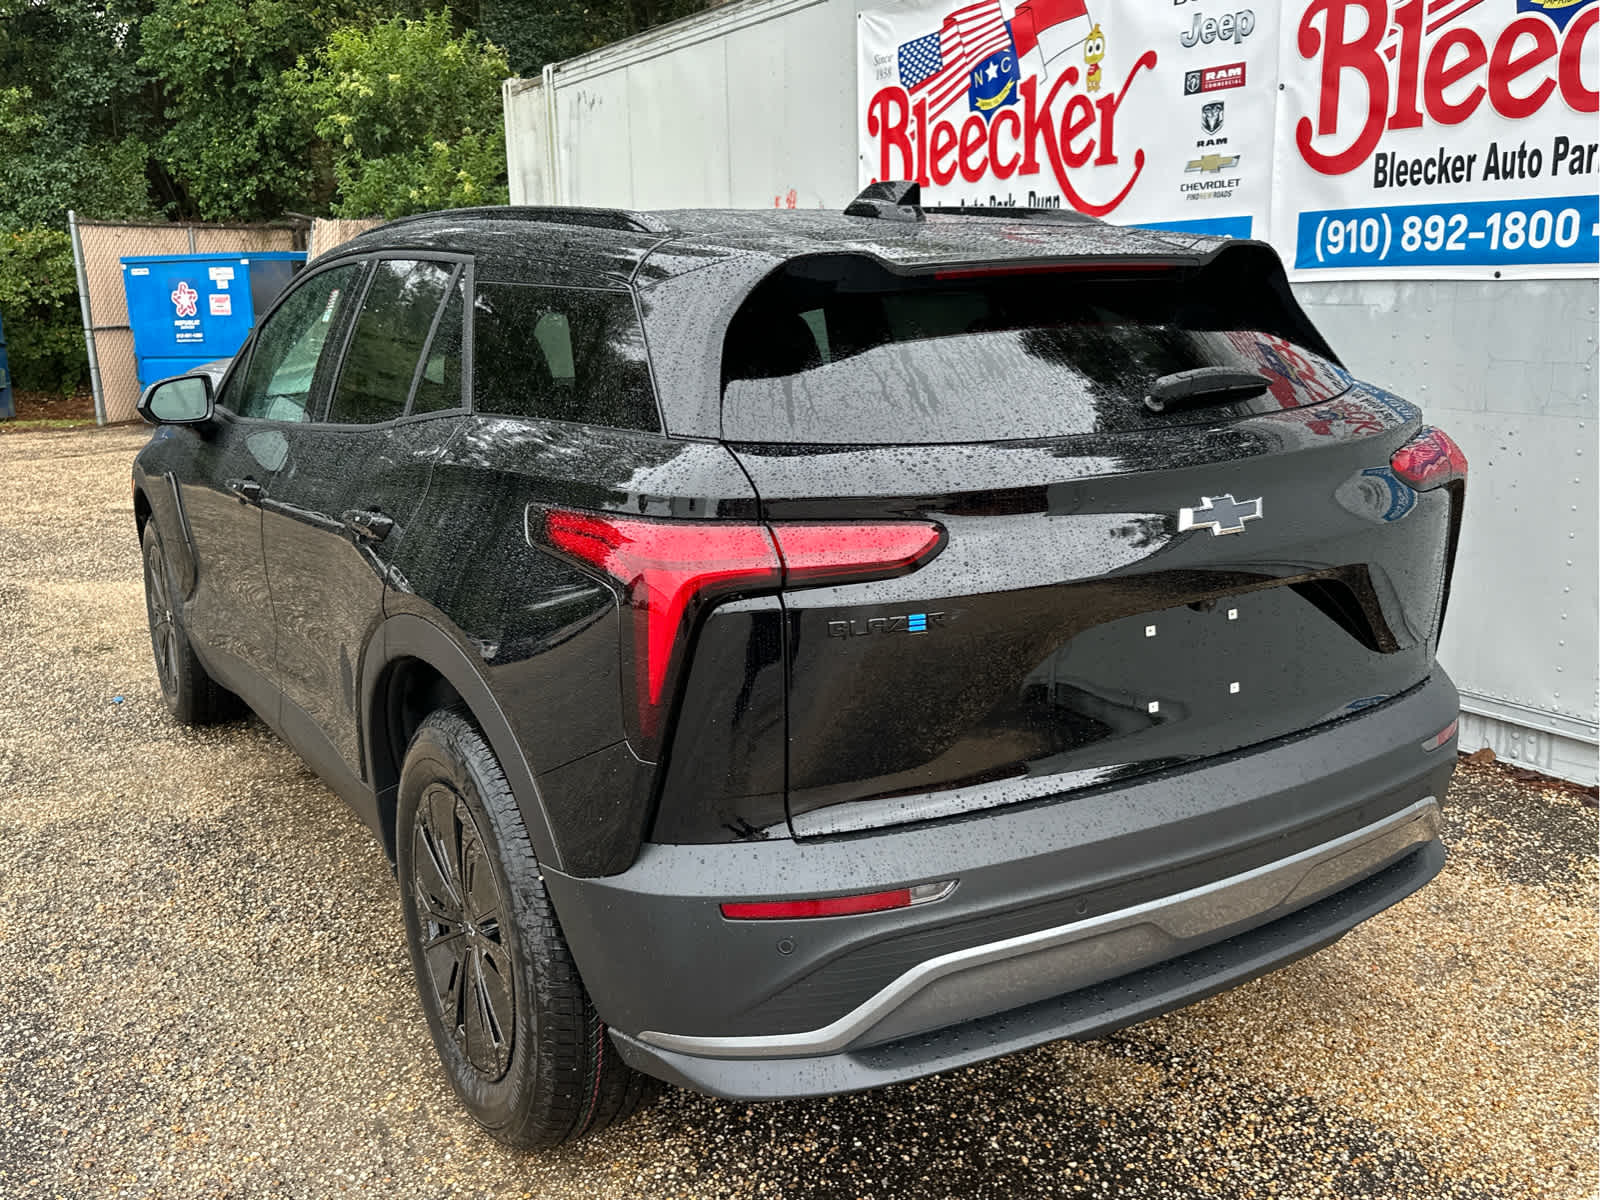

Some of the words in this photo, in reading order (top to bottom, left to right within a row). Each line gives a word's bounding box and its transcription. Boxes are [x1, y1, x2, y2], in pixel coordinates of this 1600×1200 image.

[1180, 9, 1255, 48] Jeep
[1205, 67, 1242, 80] RAM
[867, 50, 1158, 217] Bleecker
[1197, 138, 1228, 147] RAM
[1373, 147, 1477, 188] Bleecker
[1482, 140, 1542, 180] Auto
[1180, 178, 1241, 192] CHEVROLET
[1315, 213, 1392, 262] (910)
[1401, 208, 1581, 251] 892-1800
[827, 611, 945, 640] BLAZER
